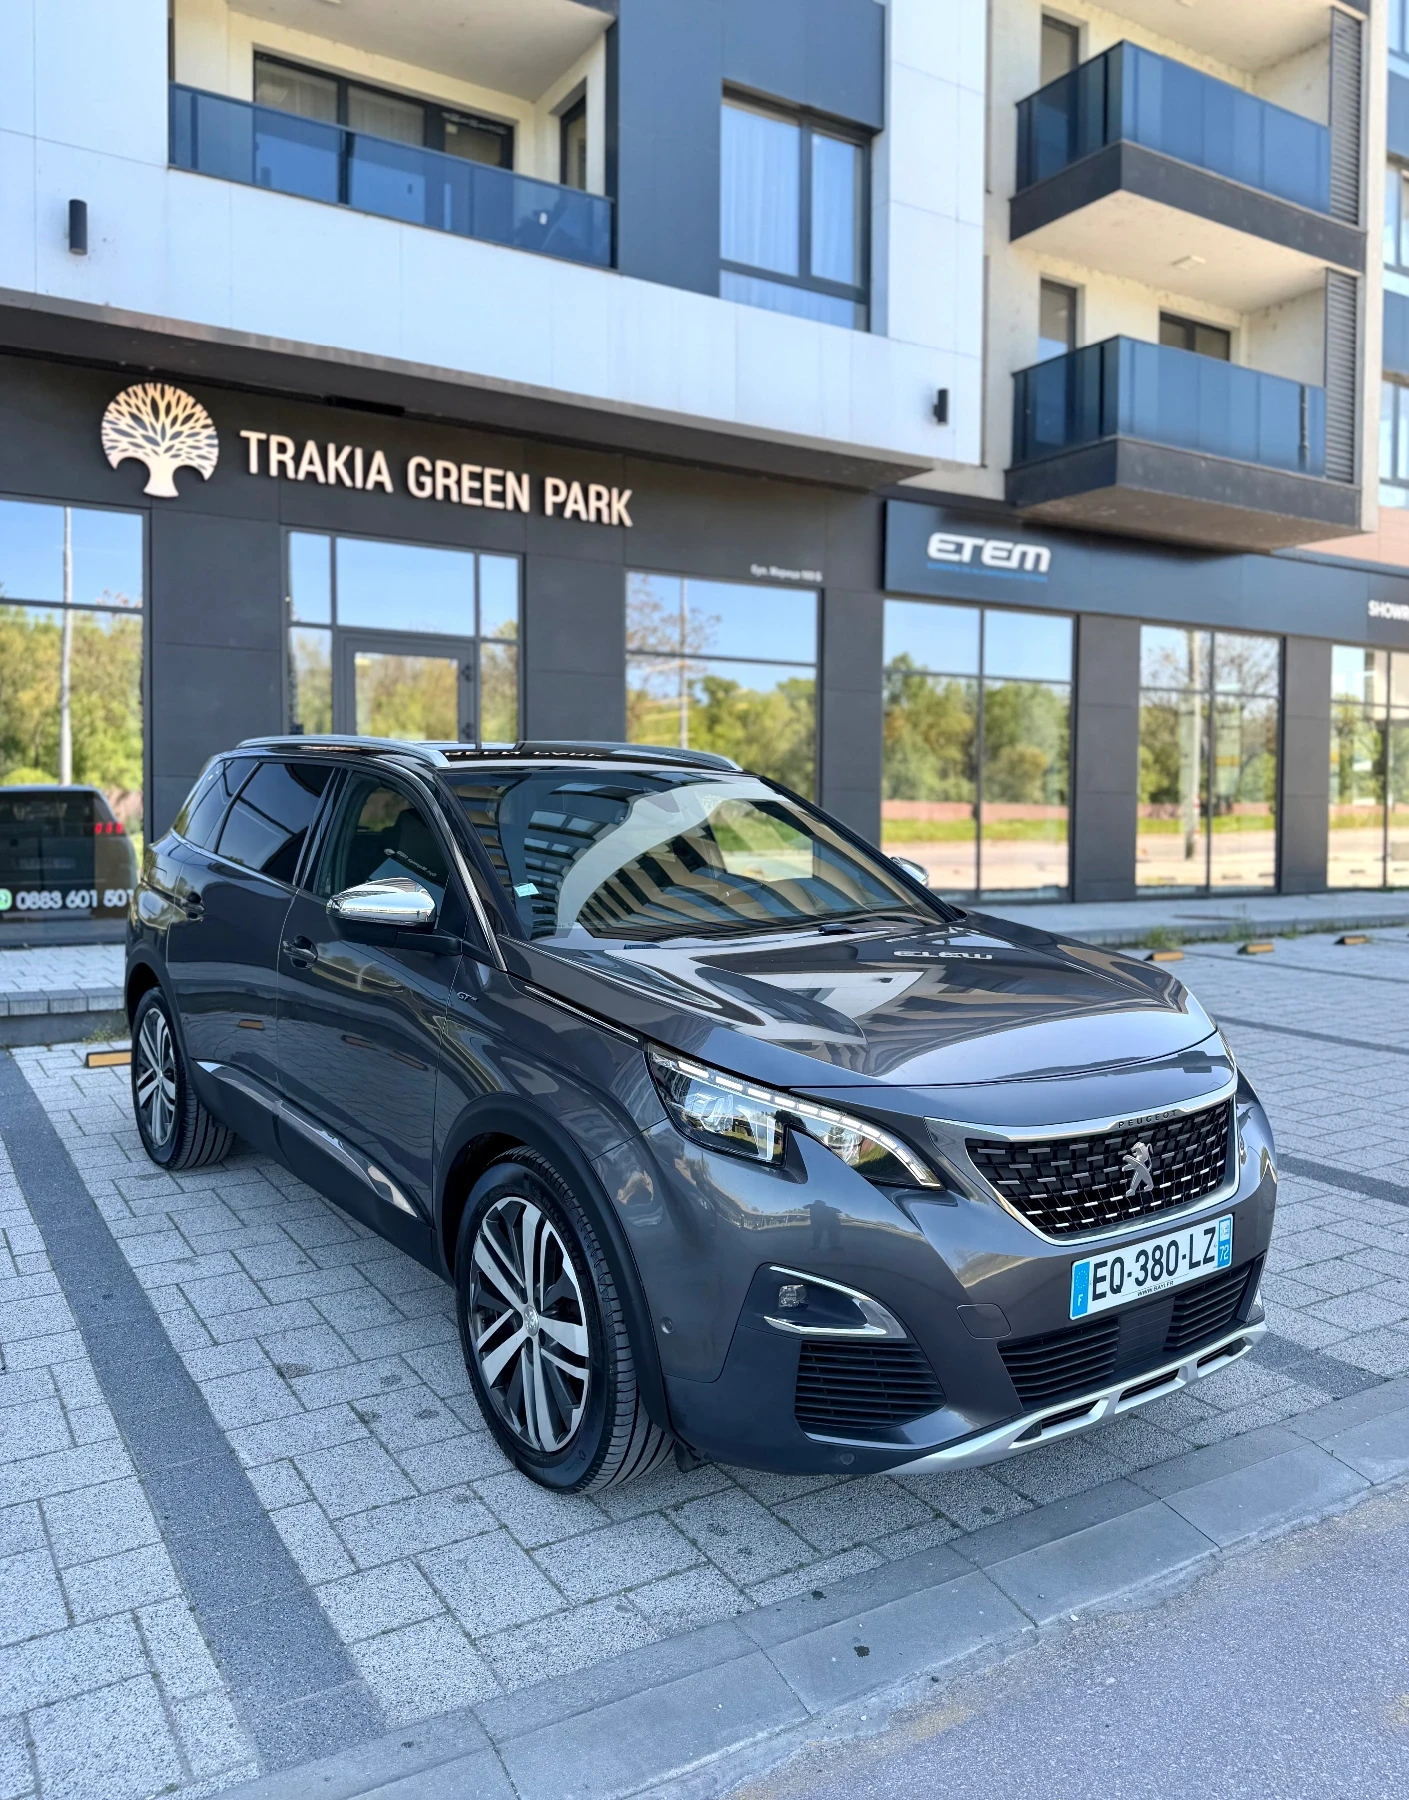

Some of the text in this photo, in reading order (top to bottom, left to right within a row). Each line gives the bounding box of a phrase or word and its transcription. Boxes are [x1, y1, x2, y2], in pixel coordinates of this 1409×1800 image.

[239, 430, 634, 528] TRAKIA GREEN PARK
[926, 531, 1052, 574] ETEM
[65, 889, 98, 909] 601
[1118, 1110, 1177, 1129] PEUGEOT
[1077, 1293, 1084, 1307] F
[1091, 1226, 1217, 1302] EQ-380-LZ
[1219, 1243, 1231, 1262] 72
